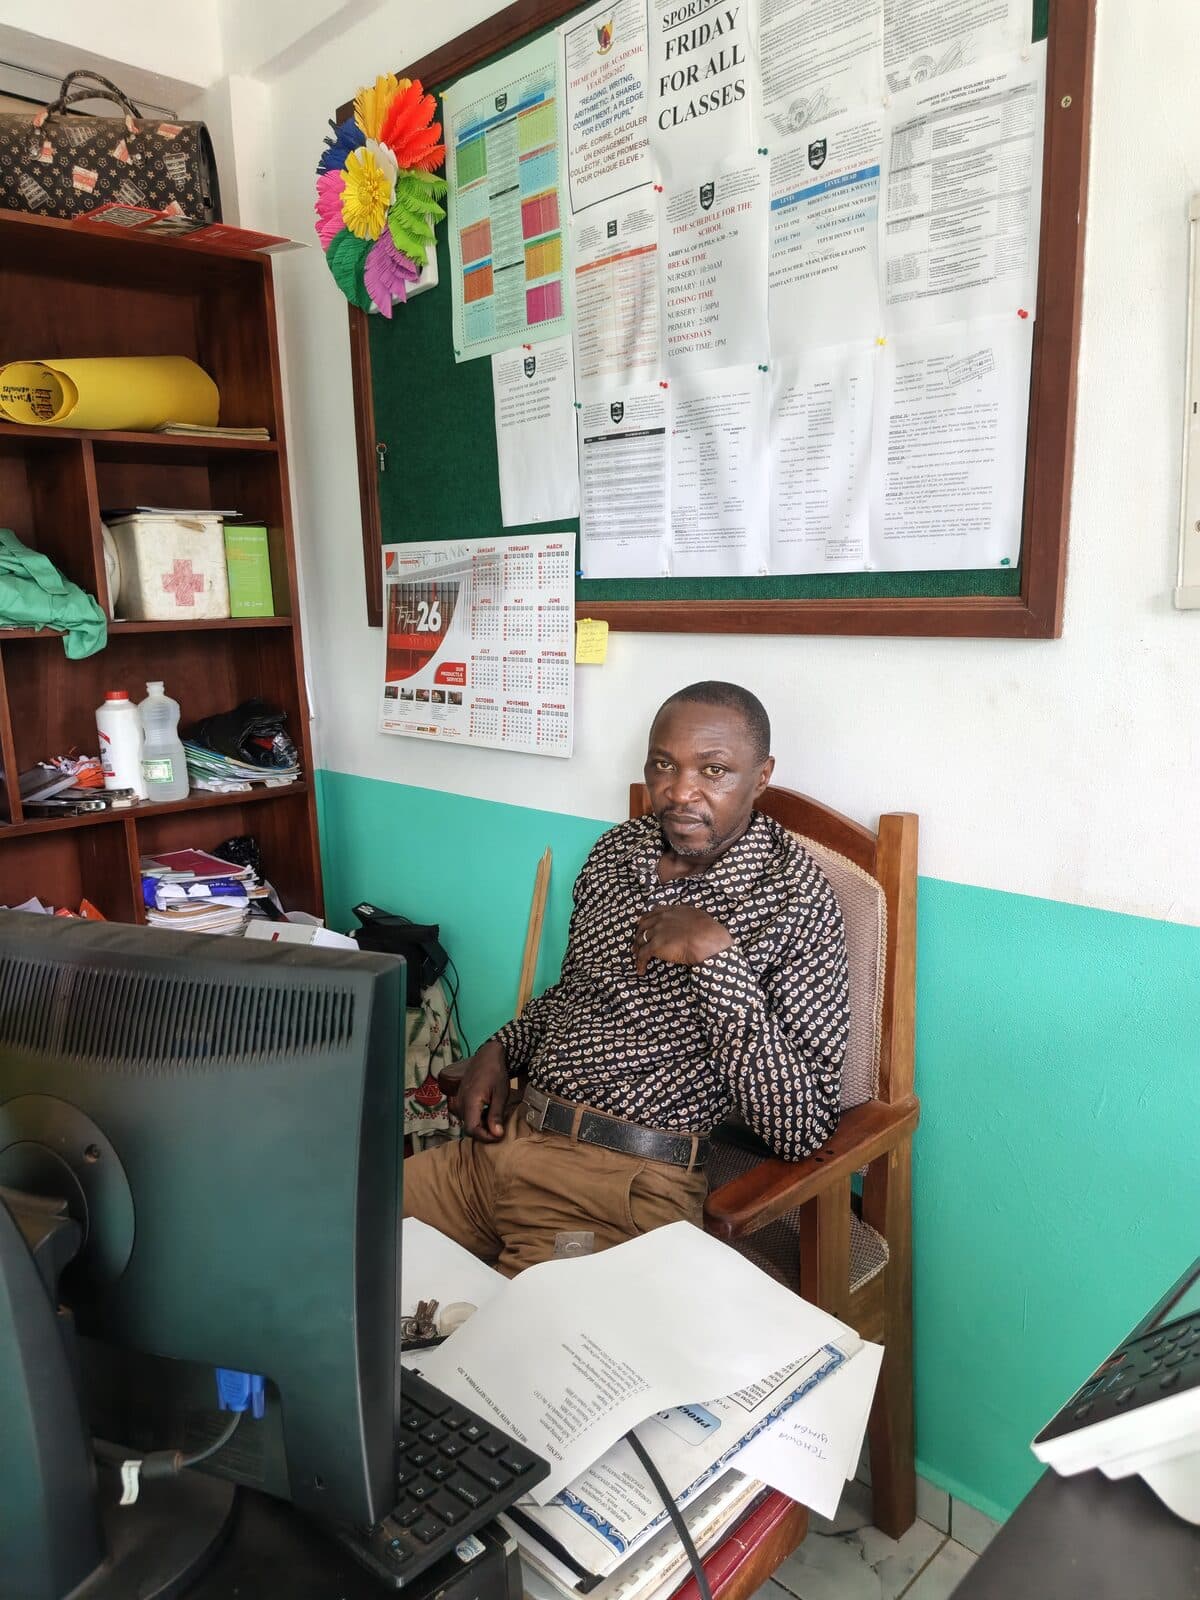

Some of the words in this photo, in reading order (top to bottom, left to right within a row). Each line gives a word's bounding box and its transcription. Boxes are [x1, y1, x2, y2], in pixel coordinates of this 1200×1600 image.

[662, 0, 719, 28] SPORTS
[664, 7, 740, 61] FRIDAY
[658, 64, 699, 97] FOR
[704, 44, 746, 79] ALL
[570, 74, 588, 88] THEME
[616, 81, 642, 97] SHARED
[619, 92, 644, 106] PLEDGE
[658, 79, 746, 130] CLASSES
[582, 126, 594, 137] FOR
[595, 117, 612, 128] EVERY
[614, 116, 647, 135] CALCULER
[584, 153, 592, 161] UN
[593, 133, 634, 157] ENGAGEMENT
[603, 152, 616, 162] UNE
[577, 174, 592, 186] POUR
[594, 162, 618, 178] CHAQUE
[619, 153, 639, 167] ELEVE
[672, 223, 689, 235] TIME
[689, 214, 720, 228] SCHEDULE
[722, 206, 736, 216] FOR
[737, 201, 752, 212] THE
[698, 222, 722, 237] SCHOOL
[668, 248, 690, 257] ARRIVAL
[668, 258, 690, 269] BREAK
[691, 252, 707, 261] TIME
[667, 295, 696, 307] CLOSING
[698, 289, 714, 300] TIME
[667, 330, 712, 344] WEDNESDAYS
[668, 345, 693, 357] CLOSING
[417, 600, 442, 632] 26
